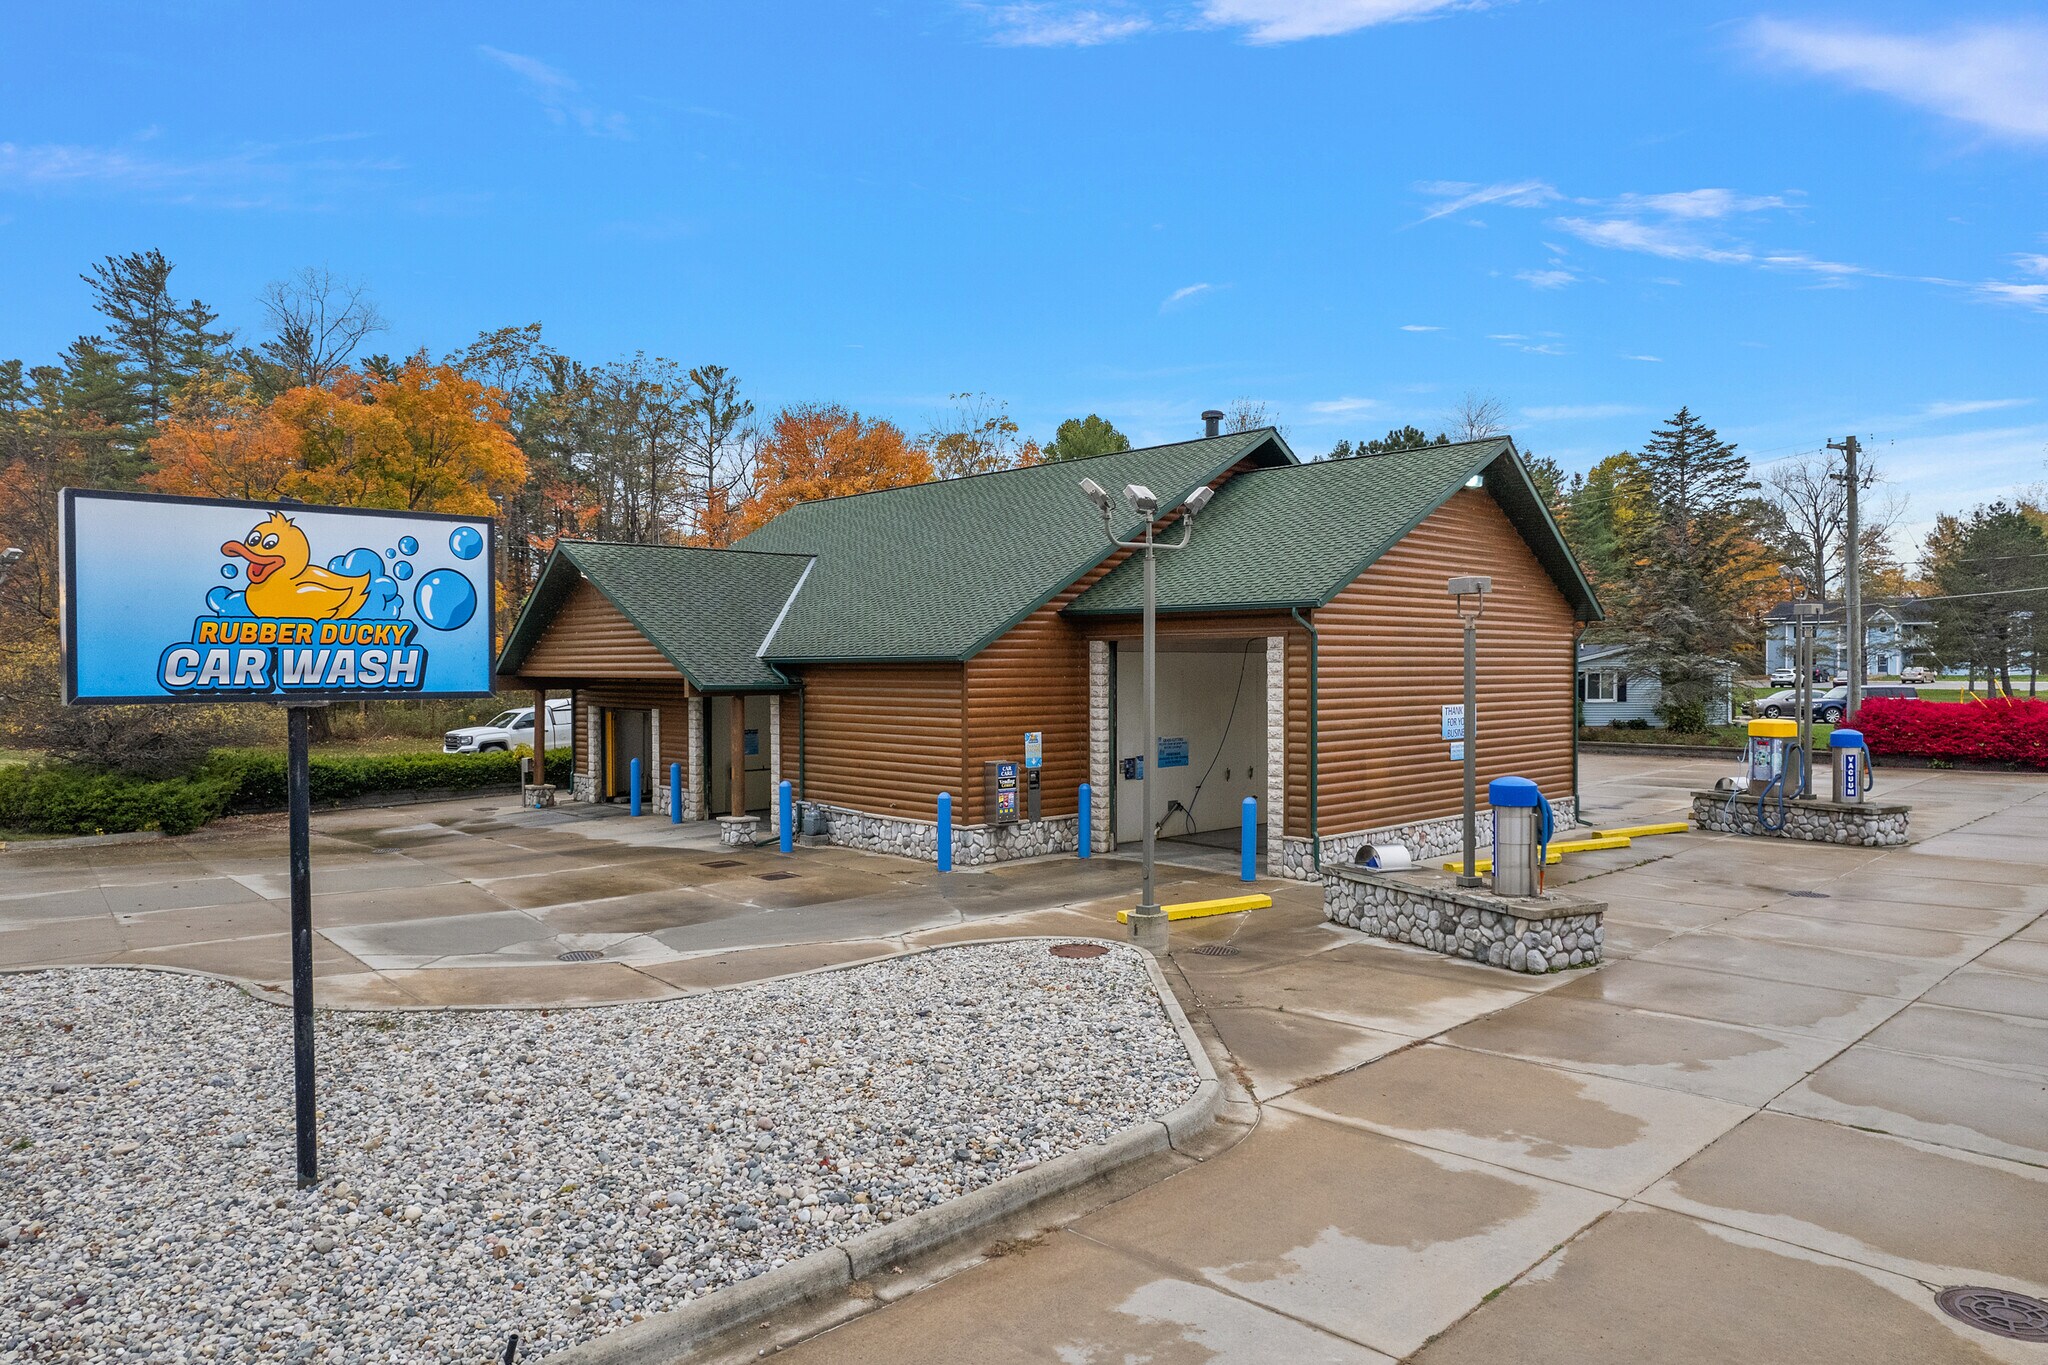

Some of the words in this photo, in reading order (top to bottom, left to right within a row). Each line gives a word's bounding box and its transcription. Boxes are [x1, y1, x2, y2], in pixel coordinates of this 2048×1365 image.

[199, 622, 313, 644] RUBBER
[320, 623, 409, 646] DUCKY
[164, 649, 267, 686] CAR
[282, 649, 420, 685] WASH
[1444, 706, 1463, 715] THANK
[1447, 718, 1457, 727] FOR
[1447, 728, 1464, 738] BUSINE
